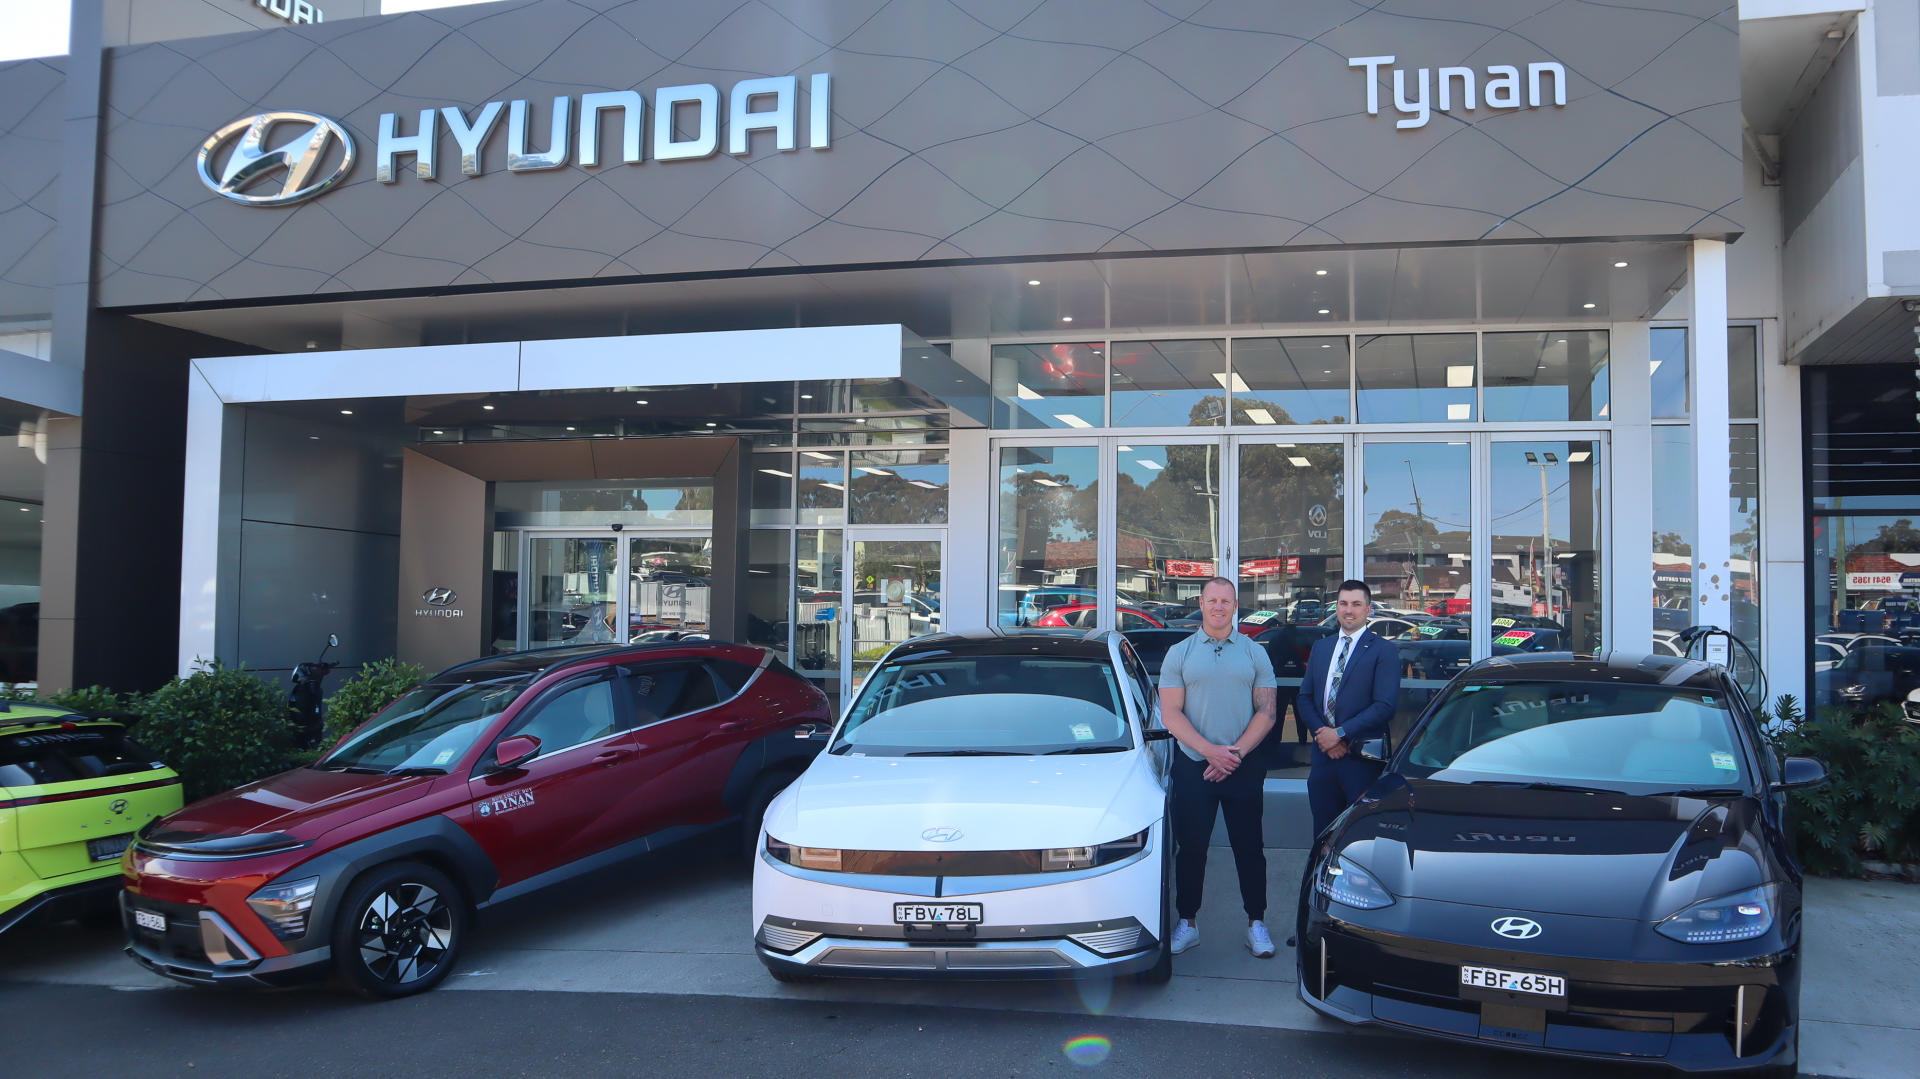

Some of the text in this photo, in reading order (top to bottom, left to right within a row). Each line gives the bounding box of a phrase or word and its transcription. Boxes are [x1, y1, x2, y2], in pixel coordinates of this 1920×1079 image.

[1348, 55, 1567, 130] Tynan
[376, 72, 832, 185] HYUNDAI
[415, 609, 464, 618] HYUNDAI
[492, 791, 534, 811] TYNAN
